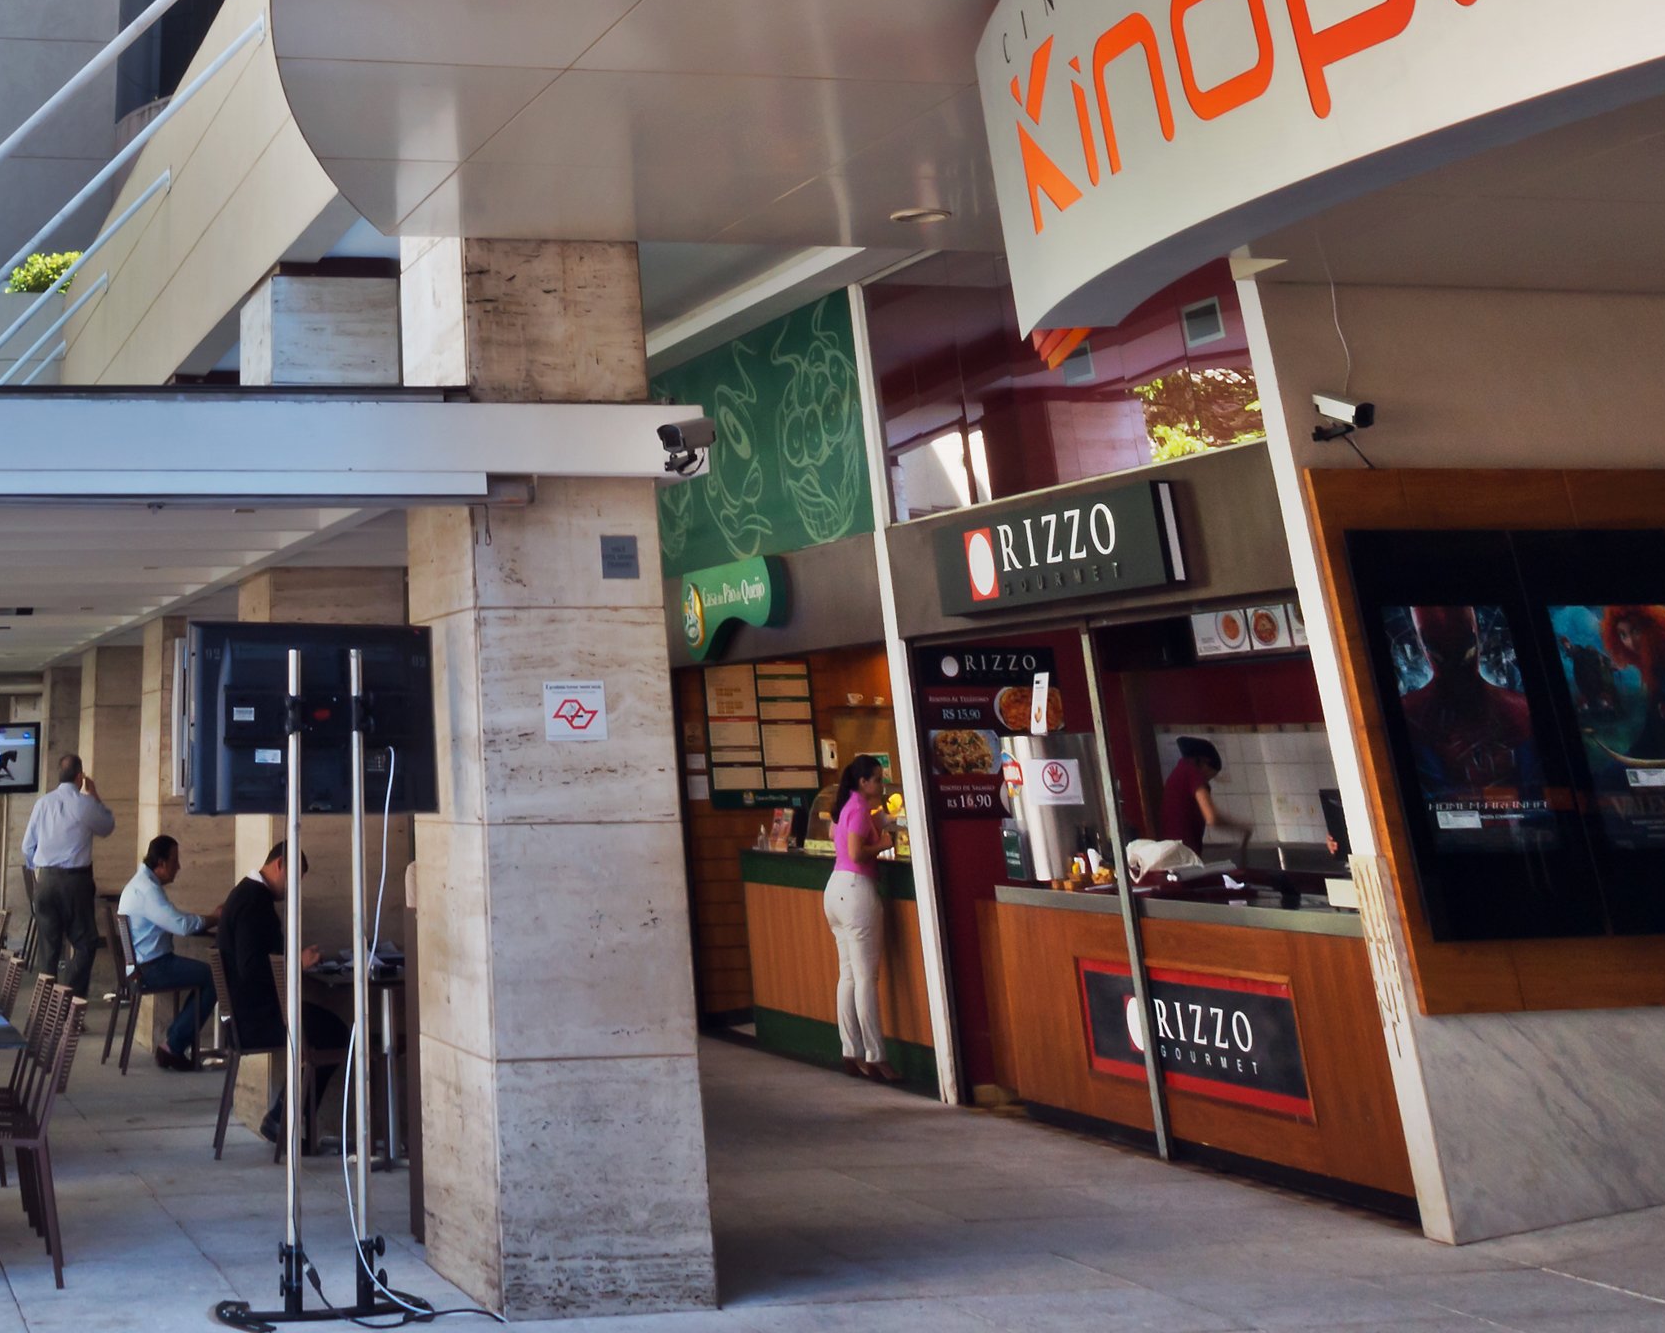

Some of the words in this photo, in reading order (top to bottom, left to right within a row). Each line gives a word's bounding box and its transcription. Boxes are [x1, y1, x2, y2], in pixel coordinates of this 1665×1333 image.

[996, 502, 1116, 572] RIZZO
[1004, 561, 1120, 596] GOURMET
[964, 654, 1037, 671] RIZZO
[960, 794, 992, 809] 16,90
[1153, 997, 1253, 1053] RIZZO
[1160, 1044, 1258, 1076] GOURMET
